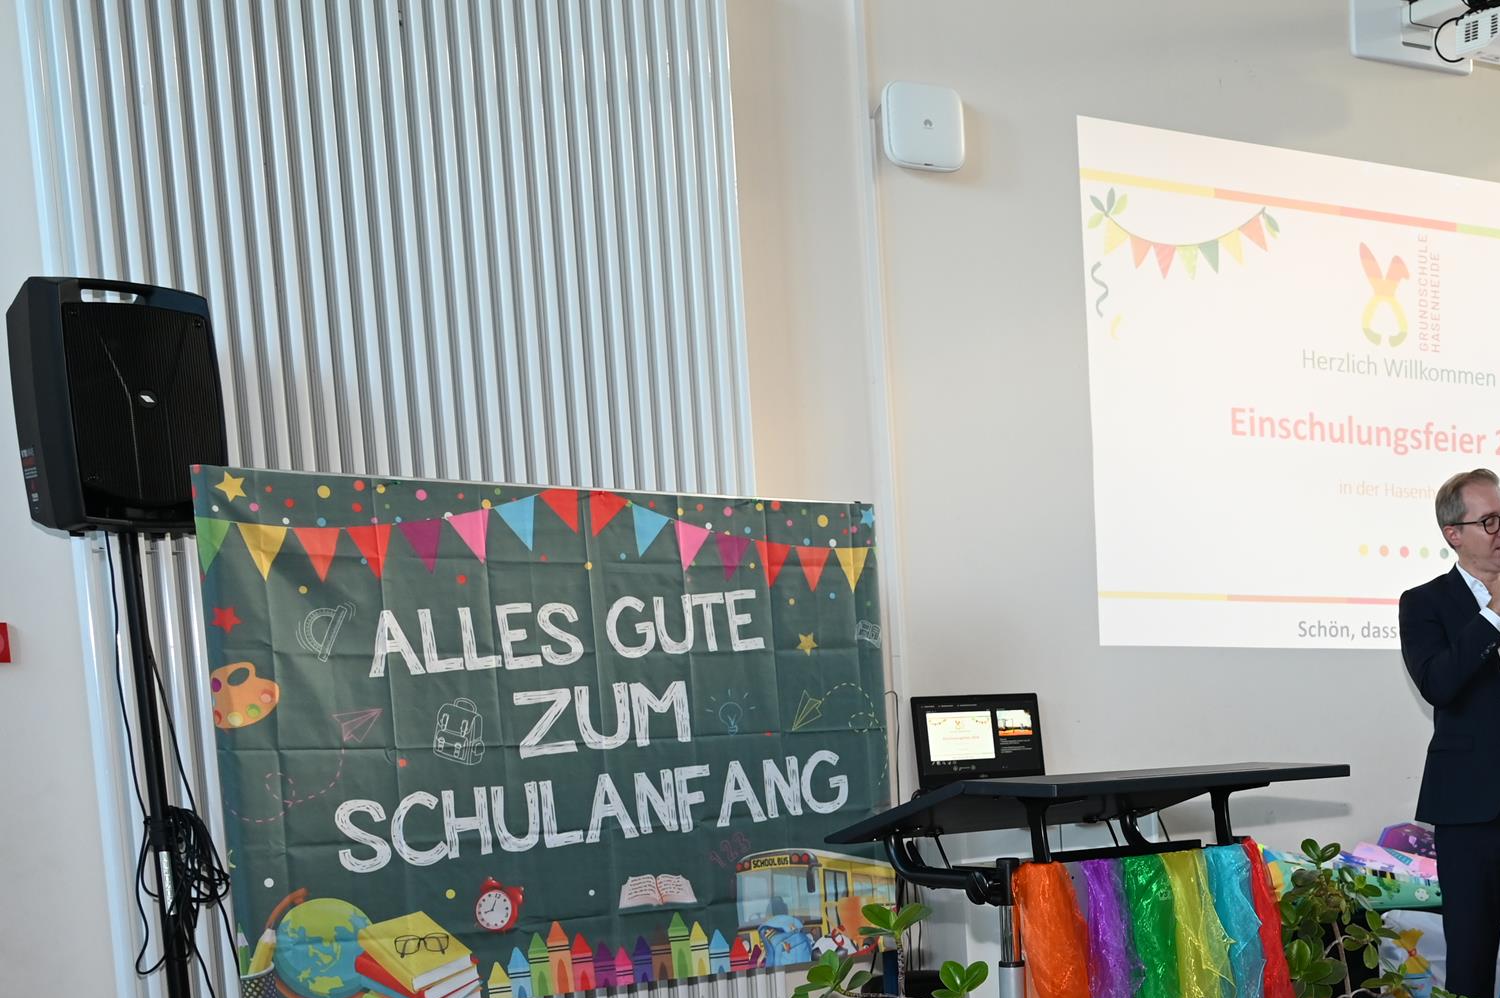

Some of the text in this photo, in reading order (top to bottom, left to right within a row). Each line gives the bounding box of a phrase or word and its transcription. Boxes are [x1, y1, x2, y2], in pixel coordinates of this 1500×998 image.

[1417, 232, 1429, 352] GRUNDSCHULE
[1429, 251, 1441, 353] HASENHEIDE
[1302, 349, 1497, 387] Herzlich Willkommen
[1230, 407, 1487, 456] Einschulungsfeier
[1338, 480, 1436, 500] in der Hasenh
[369, 589, 765, 678] ALLES GUTE
[1297, 619, 1398, 641] Schön, dass
[513, 680, 692, 760] ZUM
[335, 750, 850, 873] SCHULANFANG
[753, 856, 789, 868] SCHOOL BUS
